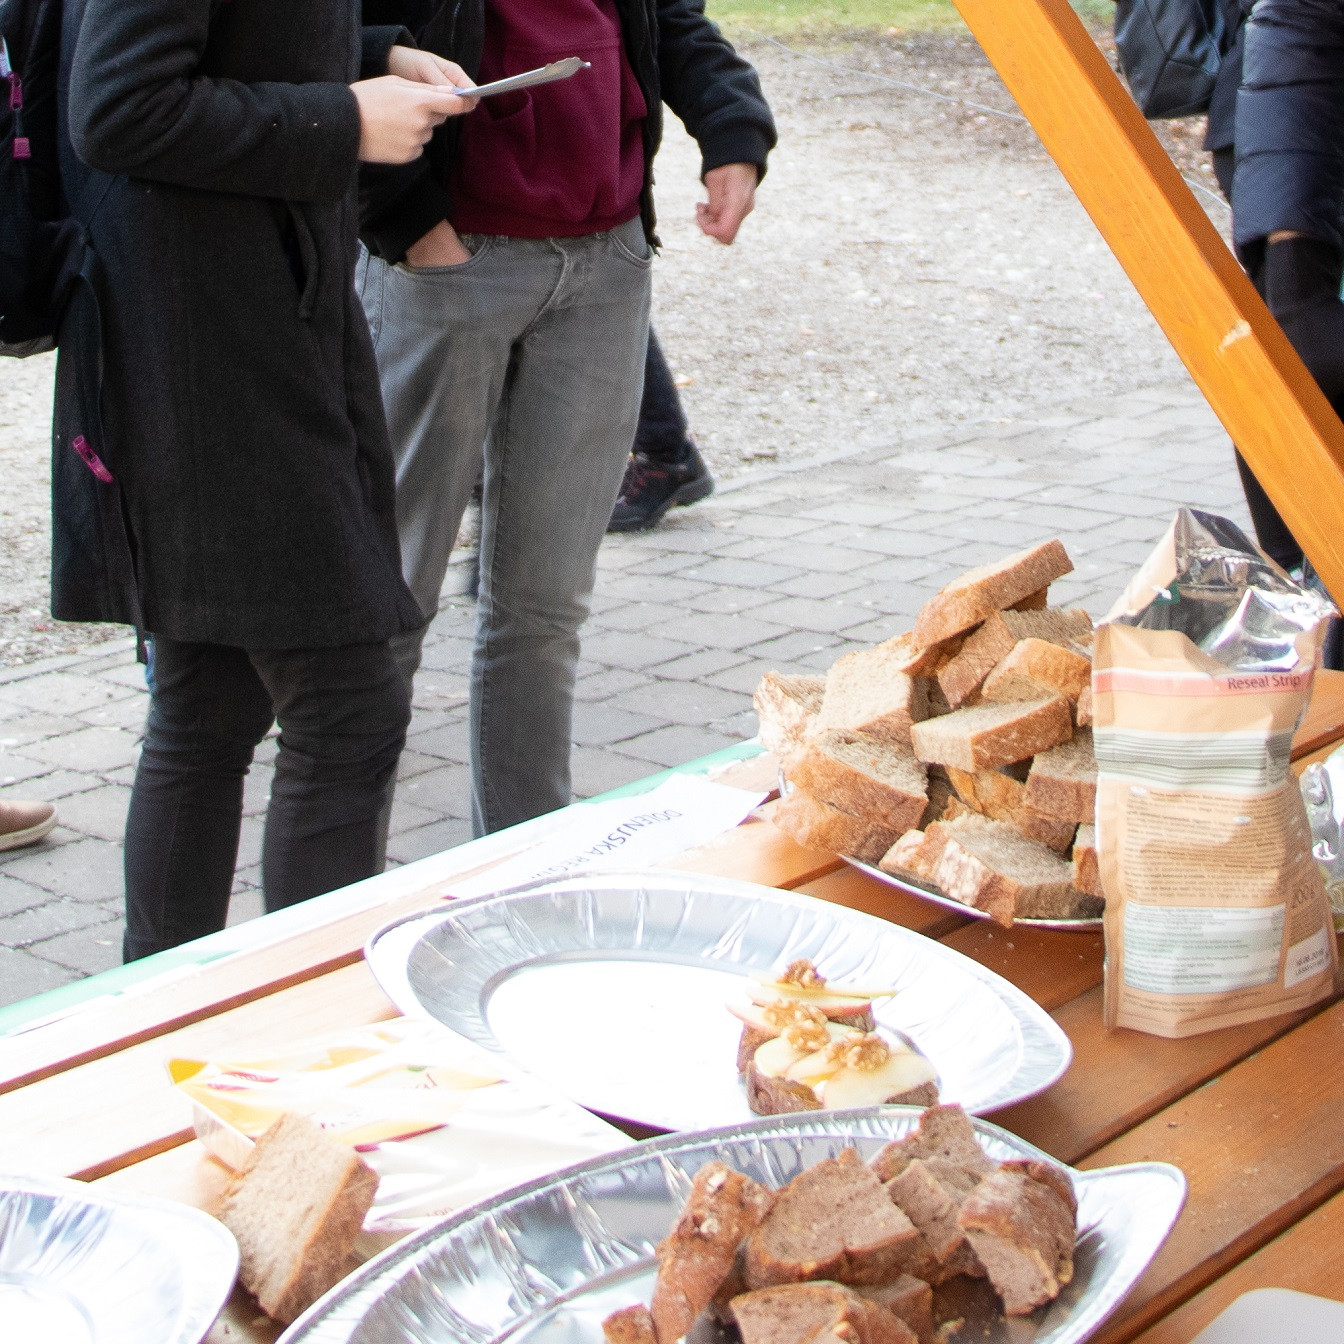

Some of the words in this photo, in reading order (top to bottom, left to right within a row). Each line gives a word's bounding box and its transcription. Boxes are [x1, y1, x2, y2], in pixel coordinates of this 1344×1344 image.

[1228, 675, 1269, 690] Reseal
[1272, 674, 1301, 688] Strip
[585, 809, 683, 856] DOLENJSKA
